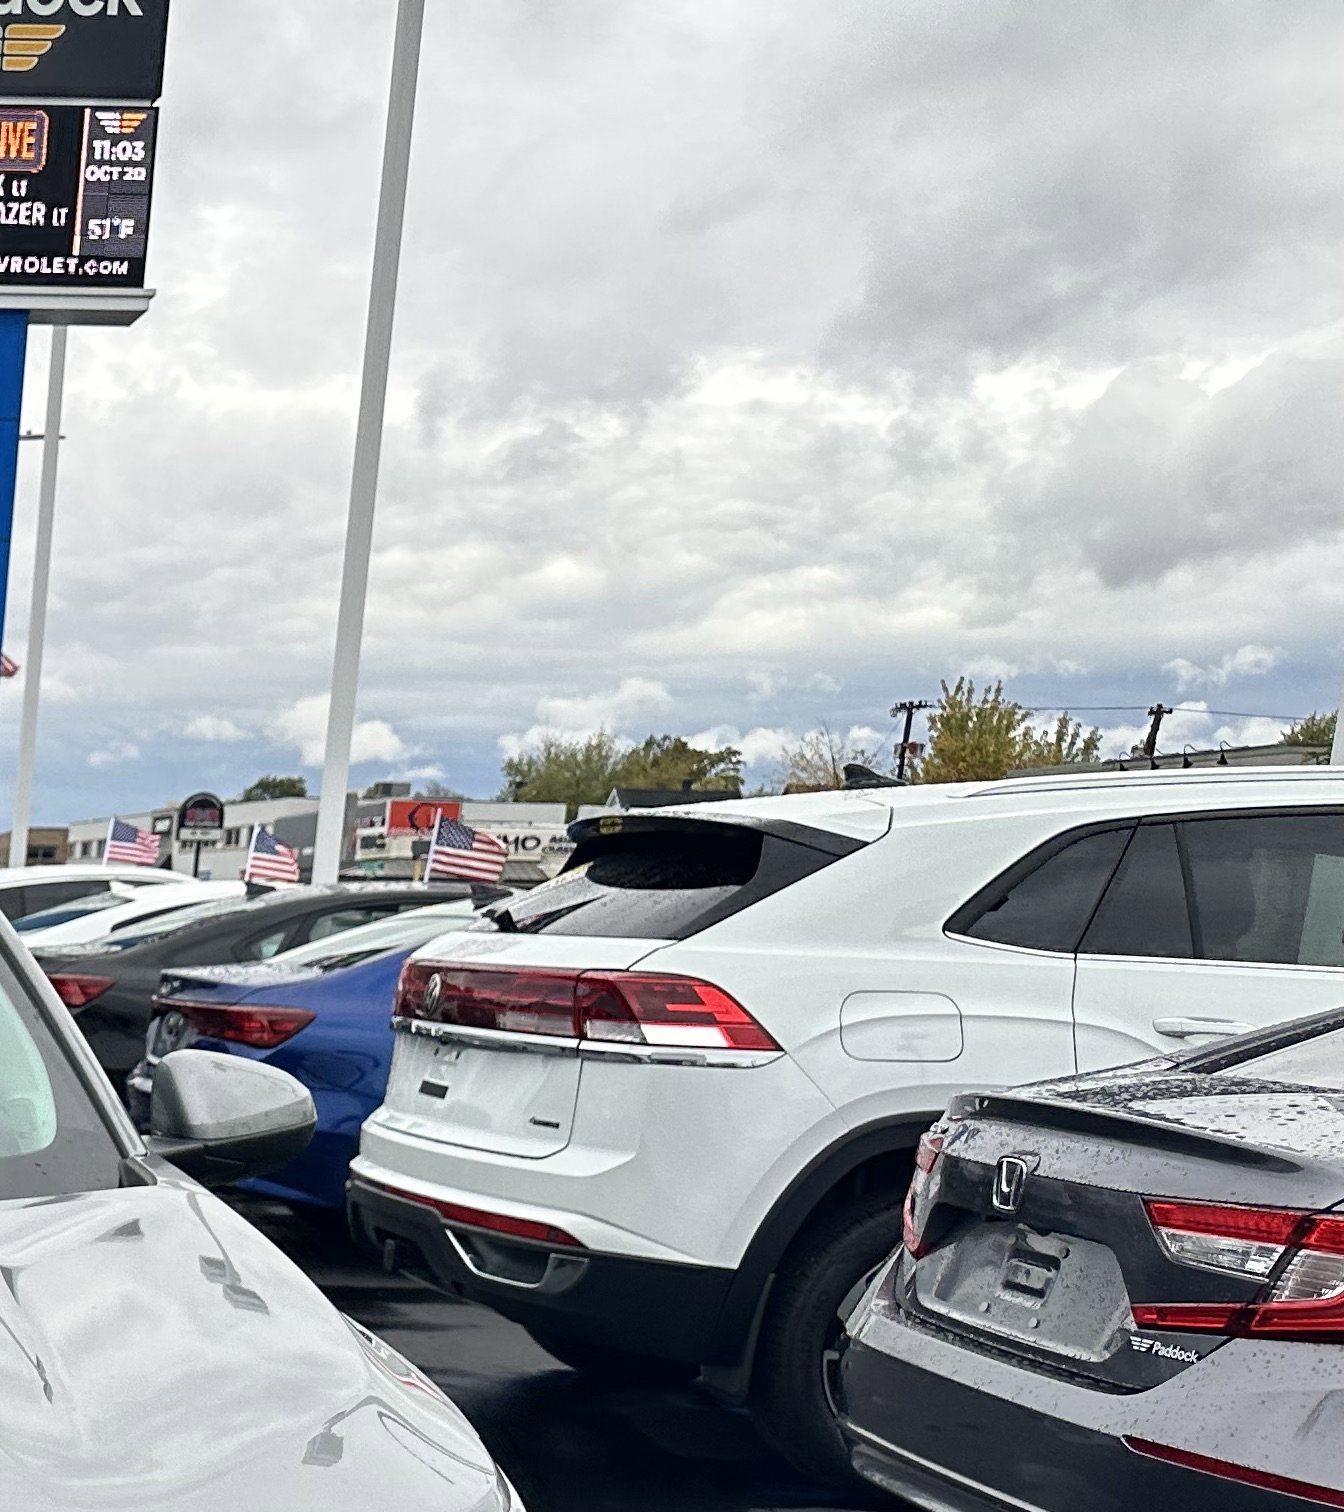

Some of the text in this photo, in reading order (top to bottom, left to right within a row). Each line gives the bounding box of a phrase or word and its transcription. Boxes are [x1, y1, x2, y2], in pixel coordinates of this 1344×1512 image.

[92, 140, 146, 161] 11:03
[85, 165, 122, 182] OCT
[52, 207, 69, 226] LT
[1152, 1341, 1199, 1363] Paddock
